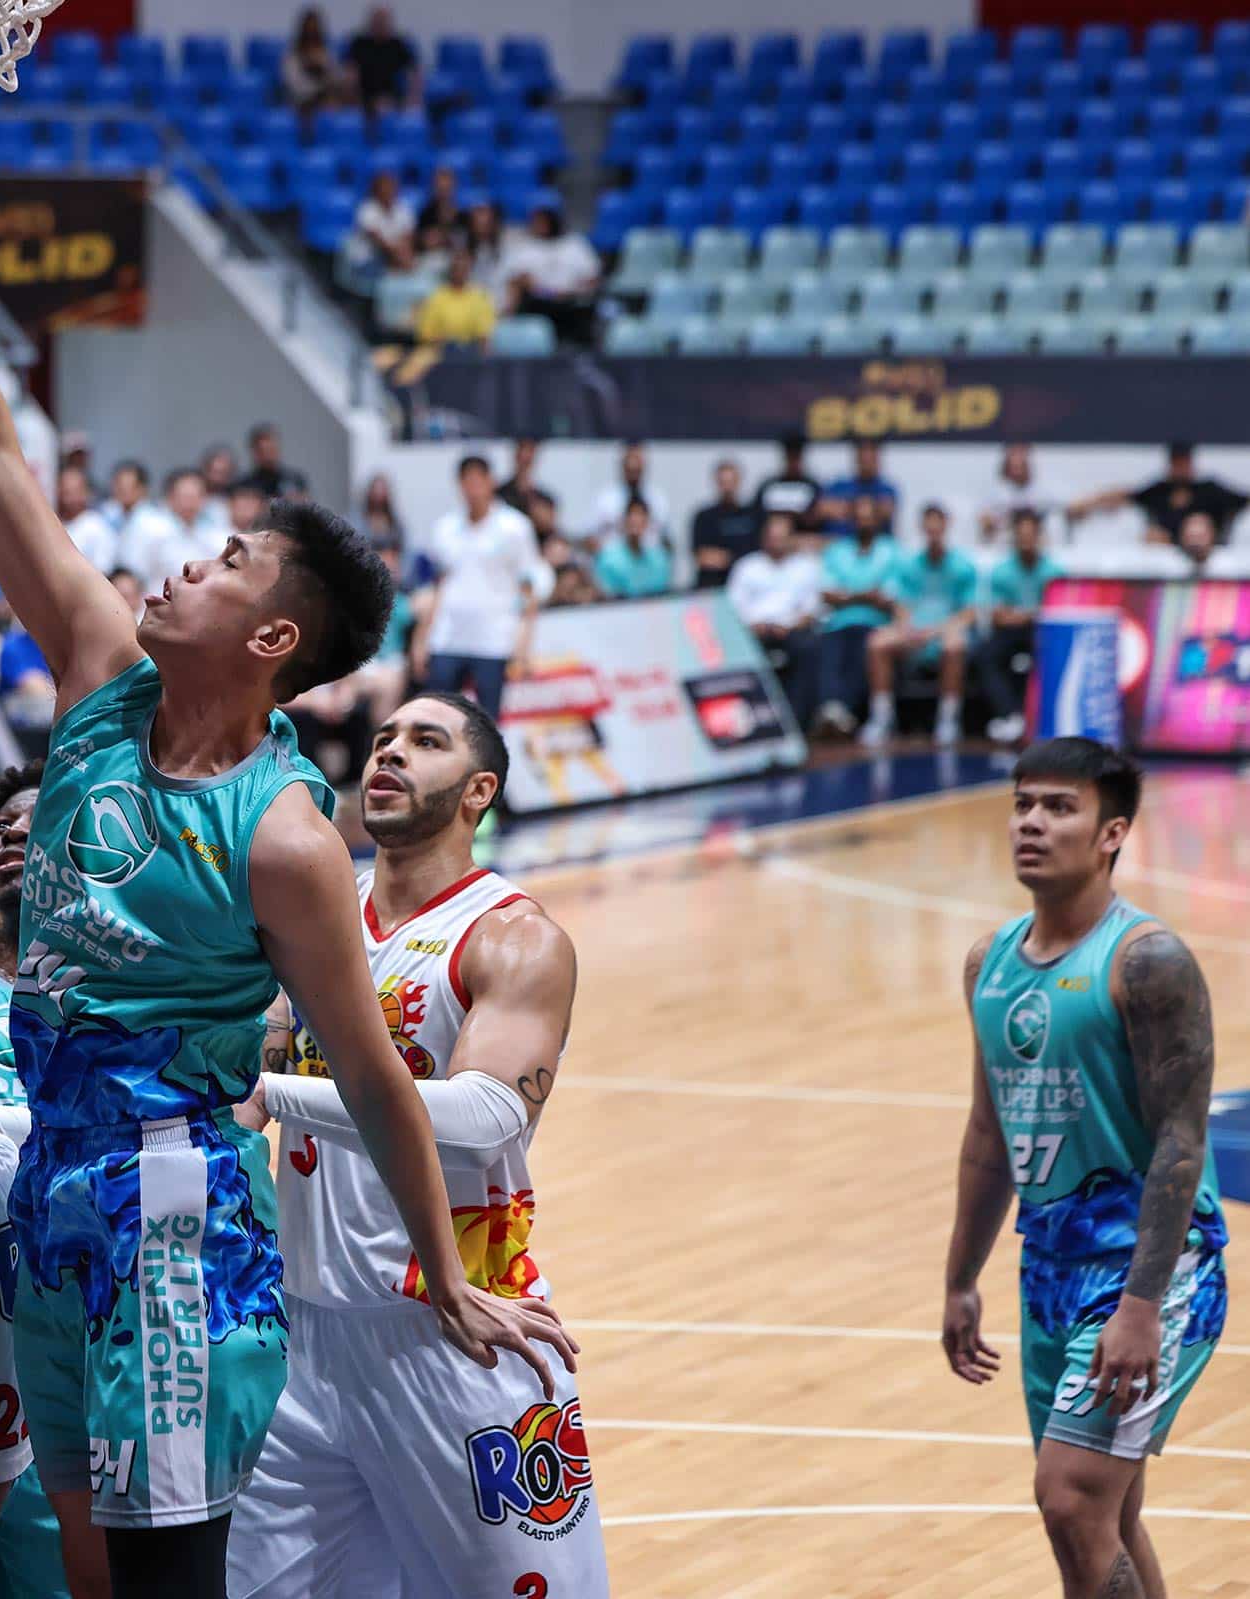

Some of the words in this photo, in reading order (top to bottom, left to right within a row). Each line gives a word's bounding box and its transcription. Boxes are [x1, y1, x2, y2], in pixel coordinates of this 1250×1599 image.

[1012, 1133, 1067, 1187] 27
[169, 1214, 201, 1287] LPG
[143, 1215, 175, 1435] PHOENIX
[173, 1299, 205, 1430] SUPER
[517, 1520, 555, 1542] ELASTO
[555, 1494, 592, 1540] PAINTERS
